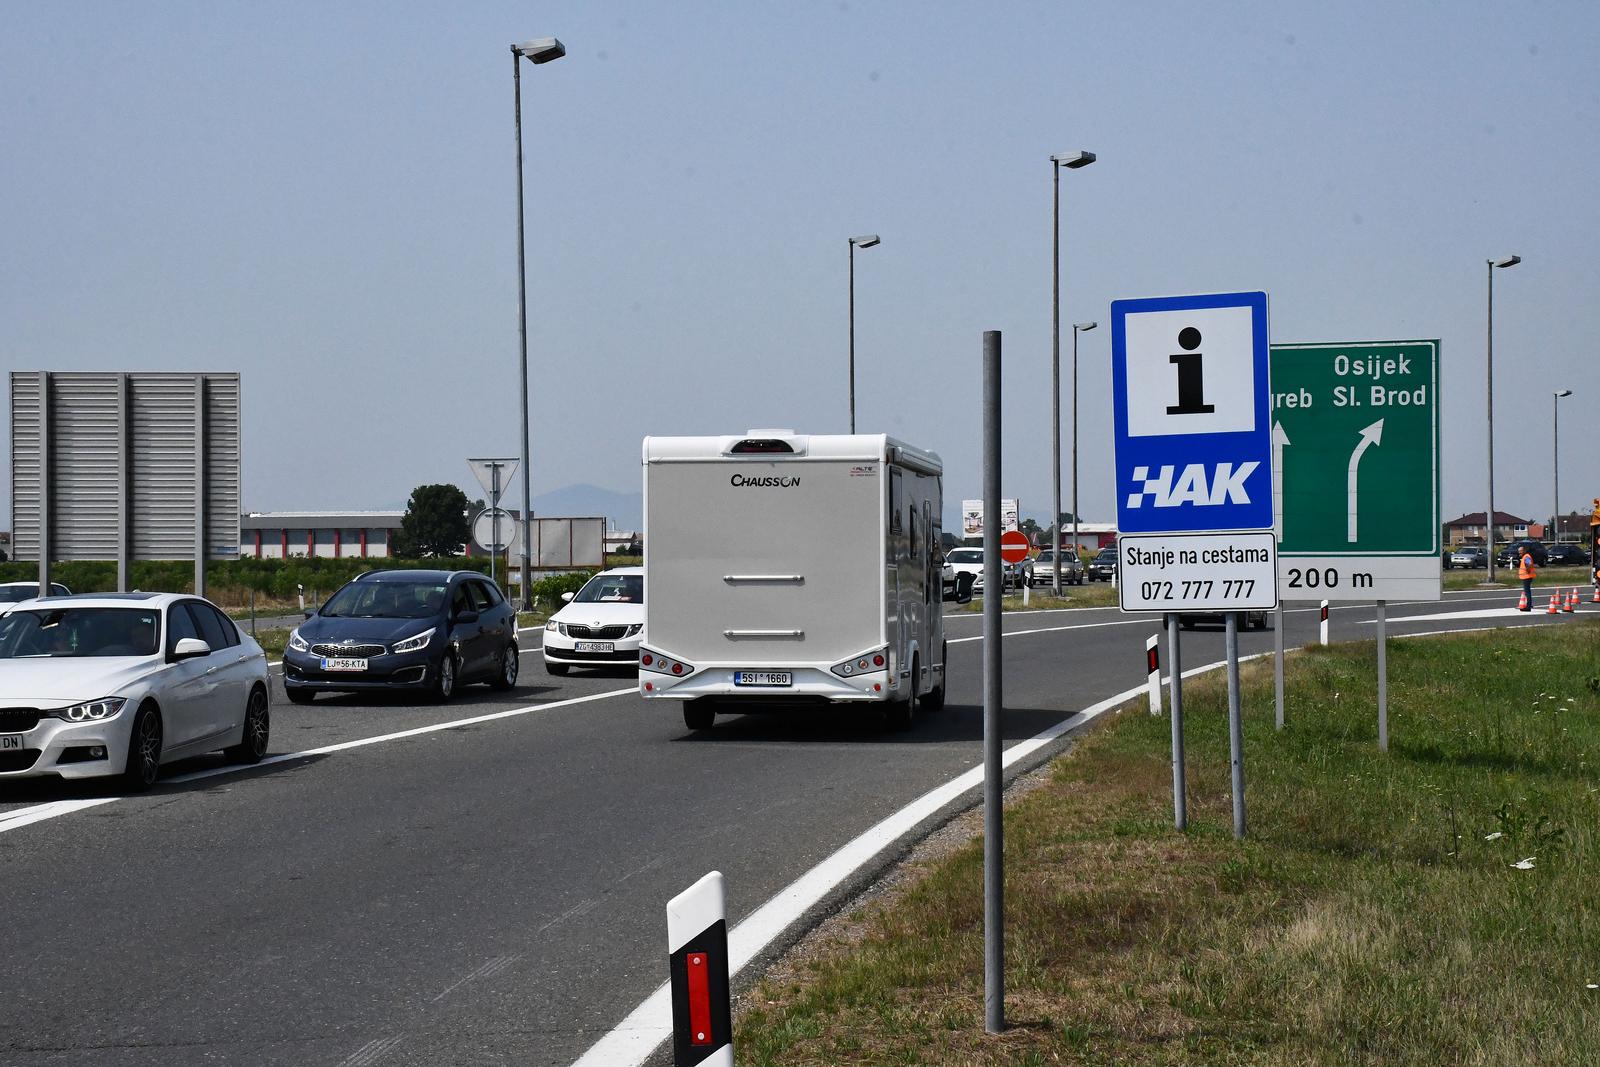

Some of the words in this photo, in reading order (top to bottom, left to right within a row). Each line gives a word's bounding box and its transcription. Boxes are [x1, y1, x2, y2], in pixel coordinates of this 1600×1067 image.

[1334, 353, 1412, 380] Osijek
[1333, 386, 1361, 407] Sl.
[1370, 385, 1426, 406] Brod
[1126, 461, 1261, 508] HAK
[1127, 547, 1175, 569] Stanje
[1179, 550, 1198, 564] na
[1202, 545, 1269, 564] cestama
[1287, 567, 1339, 589] 200
[1352, 572, 1373, 588] m
[1141, 581, 1174, 600] 072
[1181, 580, 1214, 600] 777
[1222, 579, 1255, 599] 777
[327, 659, 337, 668] LJ
[765, 673, 788, 684] 1660
[3, 736, 18, 749] DN
